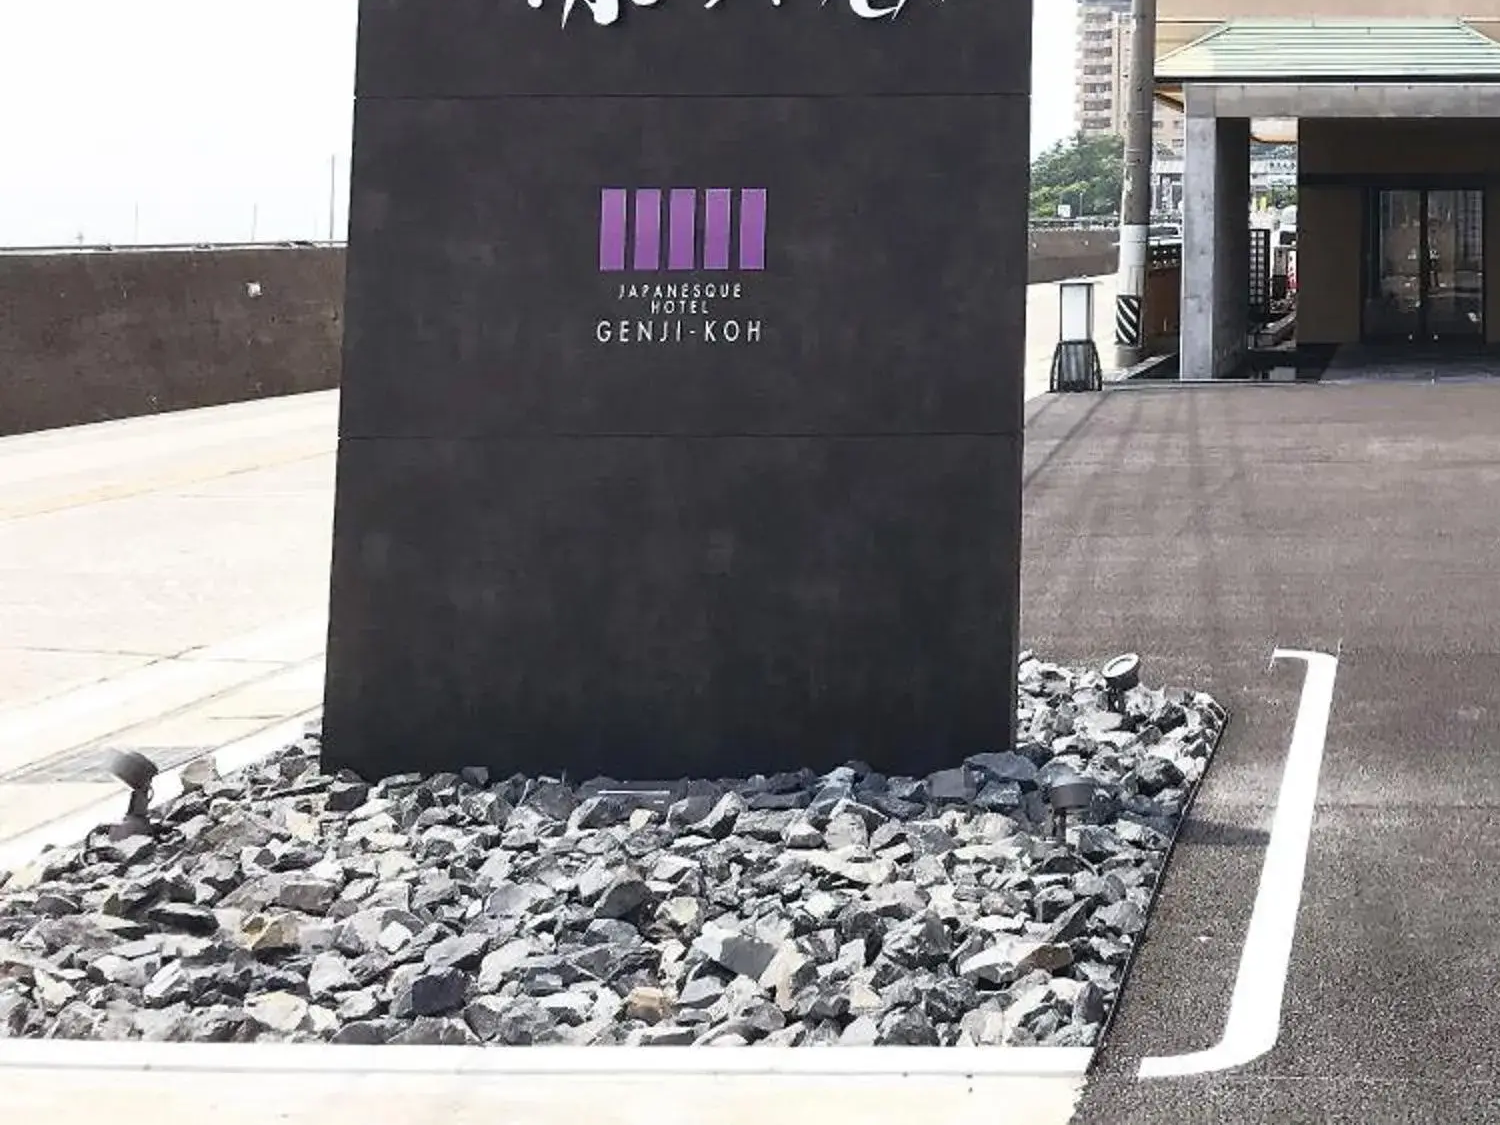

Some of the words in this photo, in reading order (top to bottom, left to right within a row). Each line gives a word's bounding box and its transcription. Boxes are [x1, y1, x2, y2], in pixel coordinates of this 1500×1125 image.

[618, 283, 742, 300] JAPANESQUE
[651, 300, 709, 315] HOTEL
[596, 320, 761, 343] GENJI-KOH
